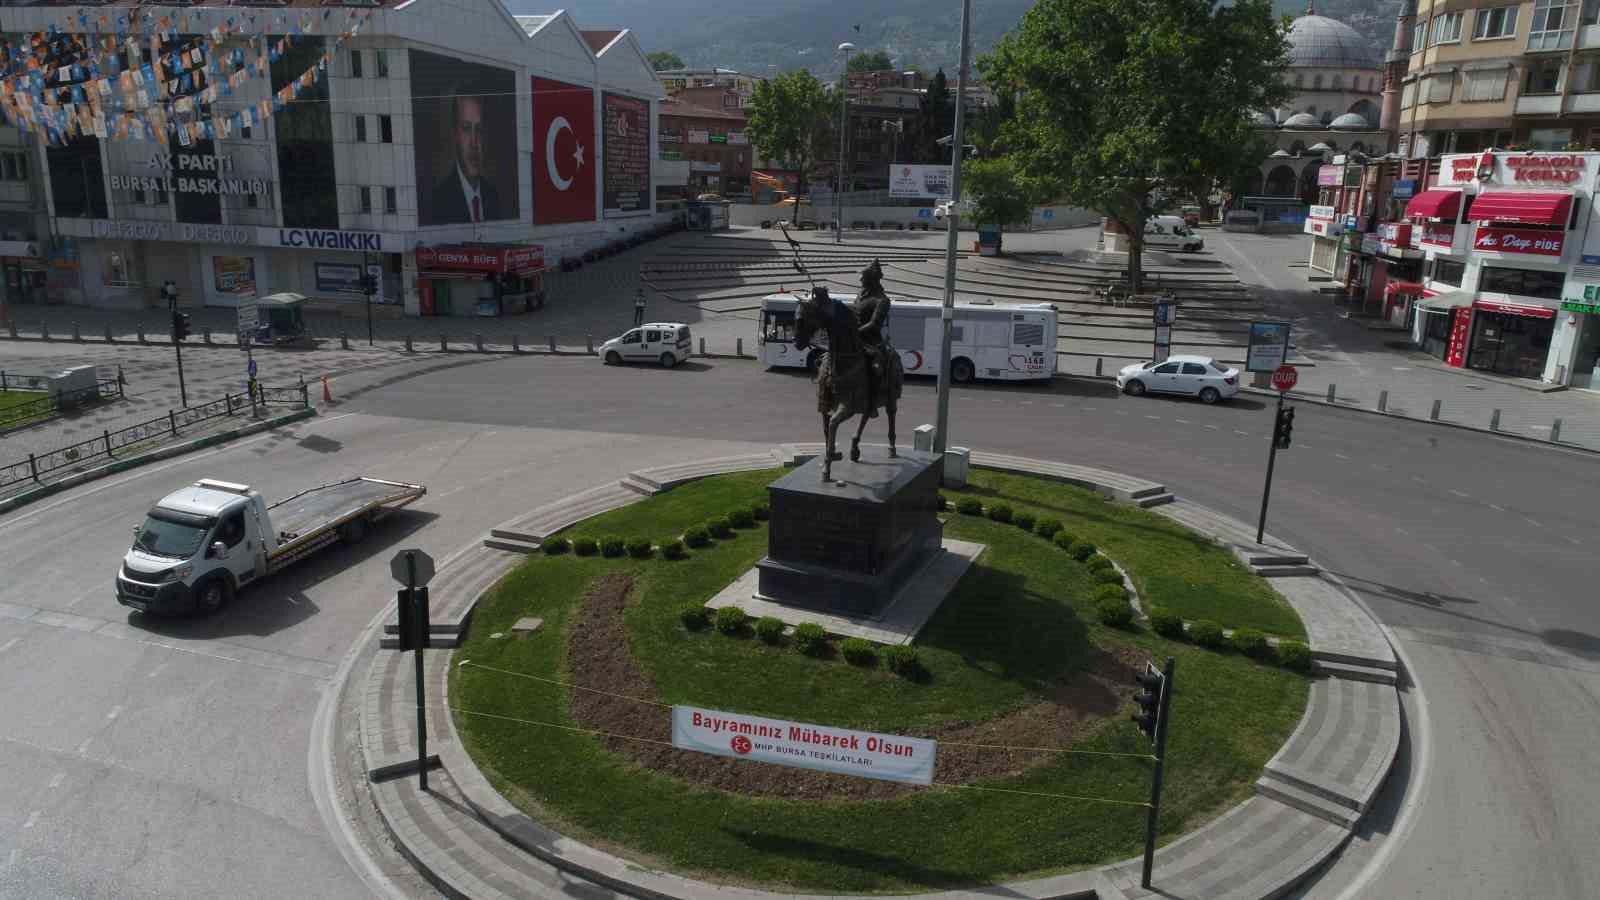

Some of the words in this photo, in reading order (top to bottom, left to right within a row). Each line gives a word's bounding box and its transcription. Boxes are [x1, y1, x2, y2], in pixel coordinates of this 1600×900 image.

[148, 152, 174, 170] AK
[111, 176, 160, 191] BURSA
[178, 178, 268, 195] BAŞKANLIĞI
[279, 230, 303, 246] LC
[1274, 372, 1296, 383] DUR
[693, 712, 782, 739] Bayramınız
[788, 726, 860, 750] Mübarek
[866, 737, 914, 757] Olsun
[754, 743, 774, 752] MHP
[776, 746, 807, 757] BURSA
[809, 750, 873, 767] TEŞKİLATLARI
